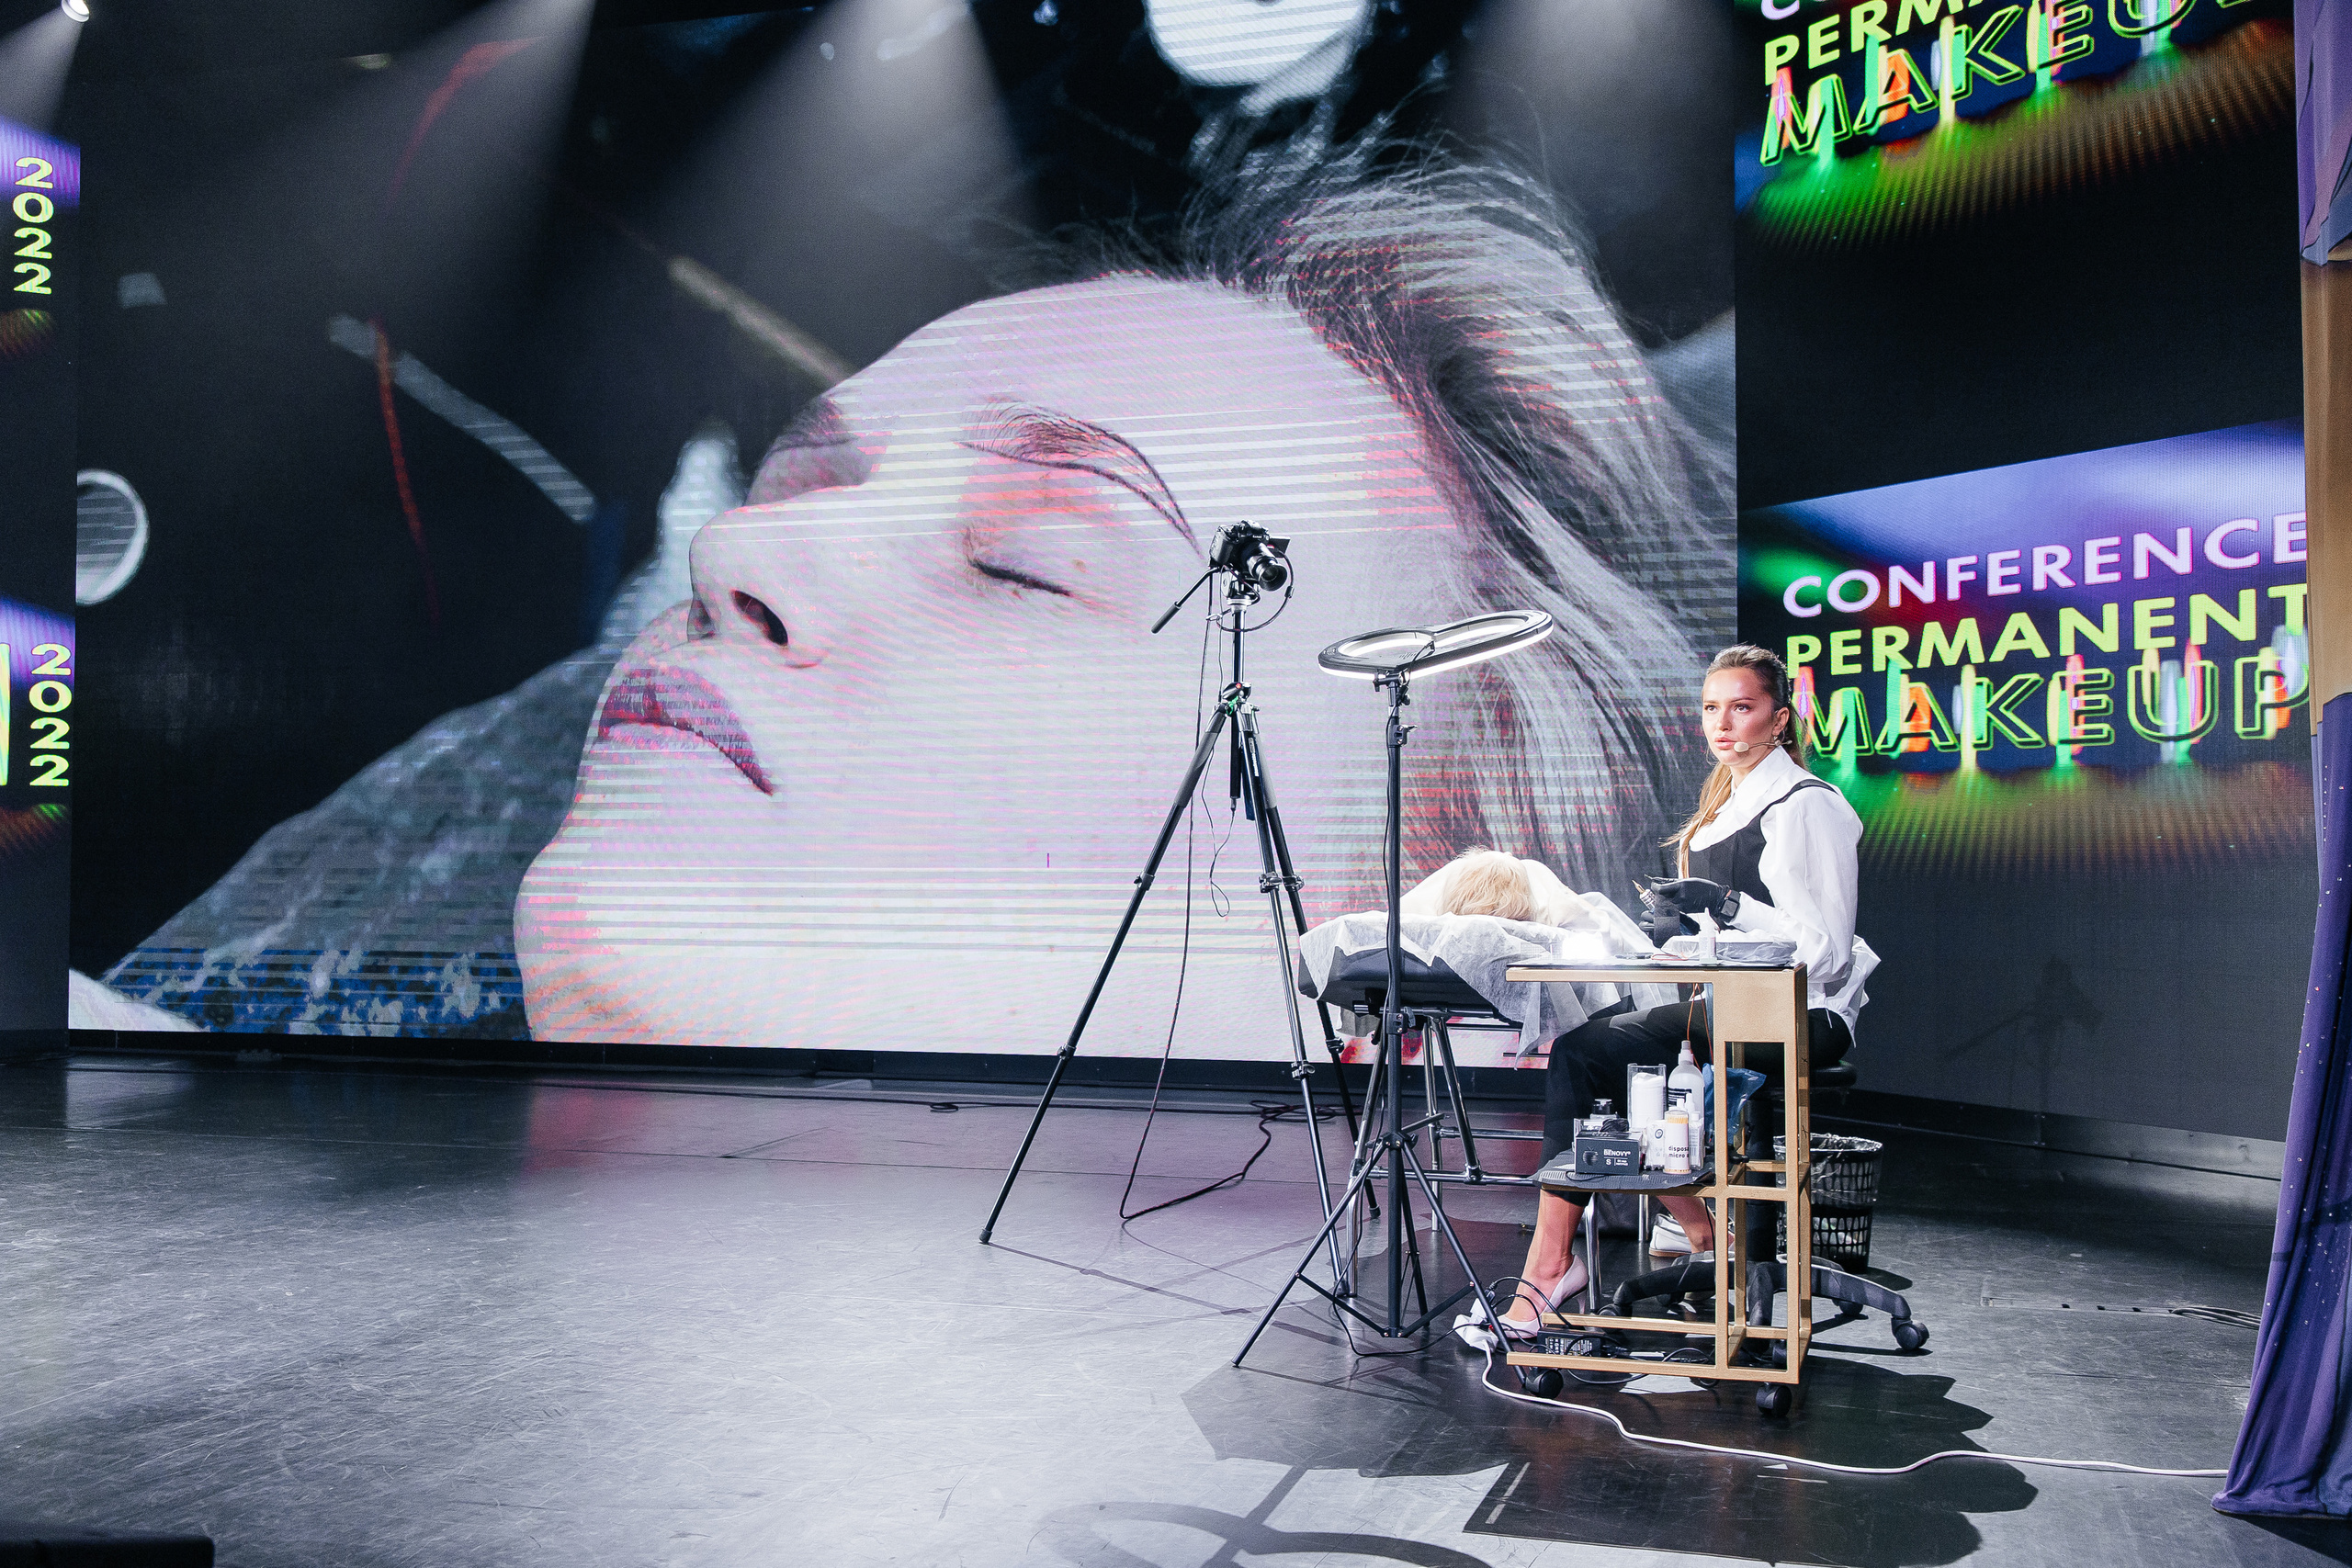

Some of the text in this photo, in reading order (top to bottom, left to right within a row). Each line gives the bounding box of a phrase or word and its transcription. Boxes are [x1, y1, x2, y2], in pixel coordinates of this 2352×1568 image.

[13, 157, 53, 294] 2022
[1783, 511, 2307, 617] CONFERENCE
[1787, 583, 2307, 679] PERMANENT
[28, 643, 72, 786] 2022
[1792, 654, 2310, 757] MAKEUP
